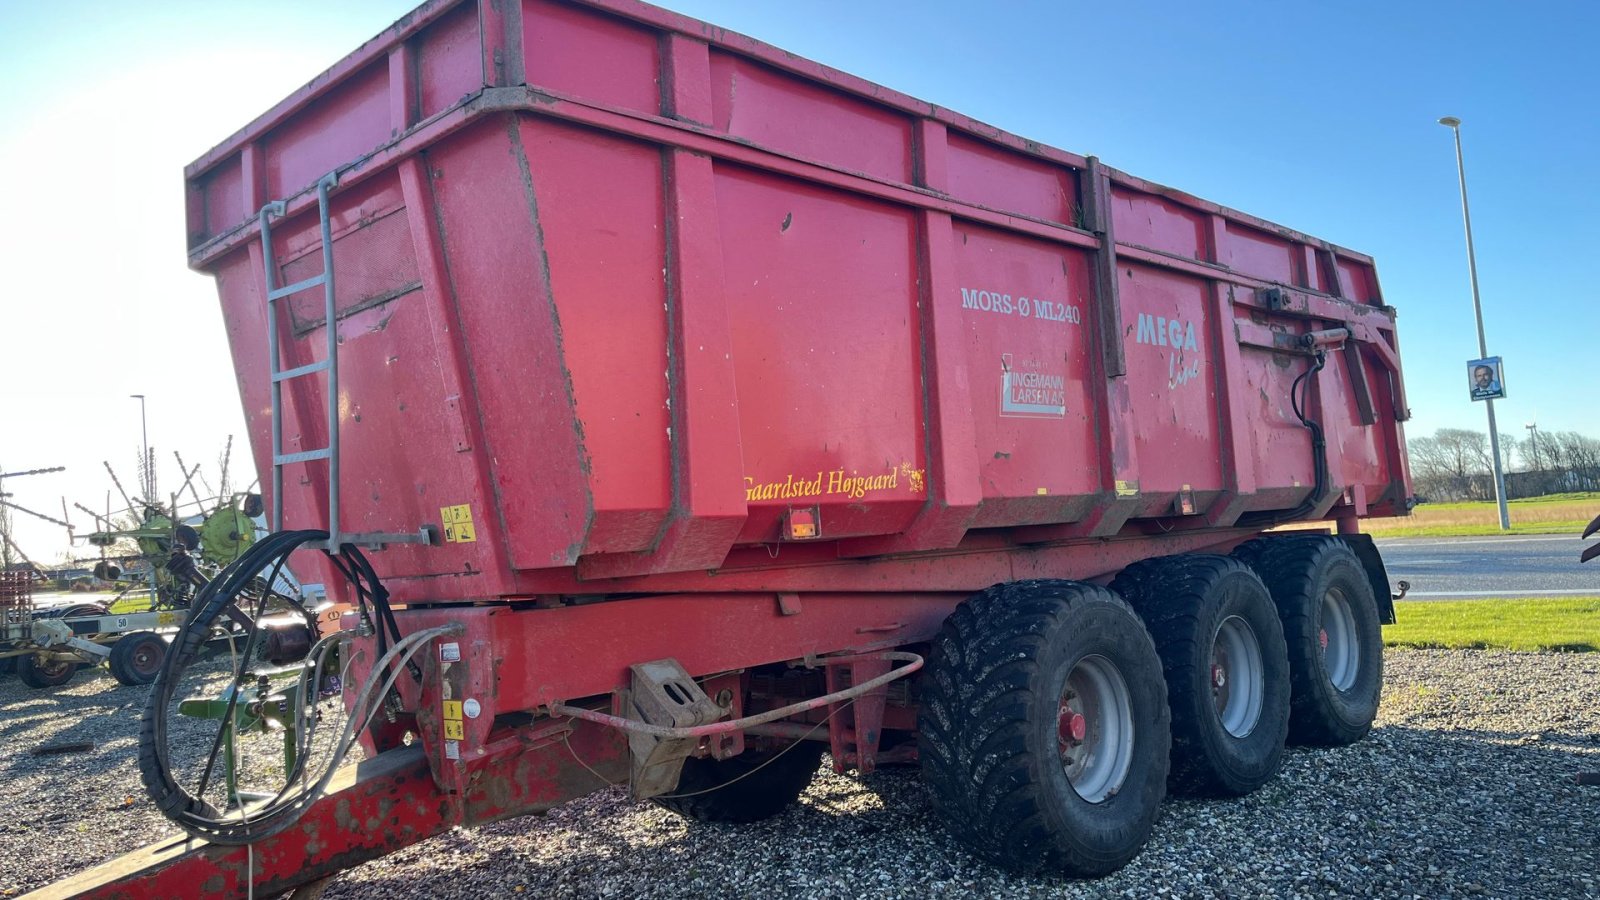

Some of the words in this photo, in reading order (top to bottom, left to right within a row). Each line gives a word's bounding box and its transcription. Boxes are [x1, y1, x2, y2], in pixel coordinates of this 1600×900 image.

[961, 288, 1031, 317] MORS-Ø
[1034, 300, 1080, 324] ML240
[1137, 313, 1197, 351] MEGA
[1012, 372, 1065, 390] INGEMANN
[1012, 387, 1049, 404] LARSEN
[827, 467, 898, 499] Højgaard
[118, 618, 127, 628] 50
